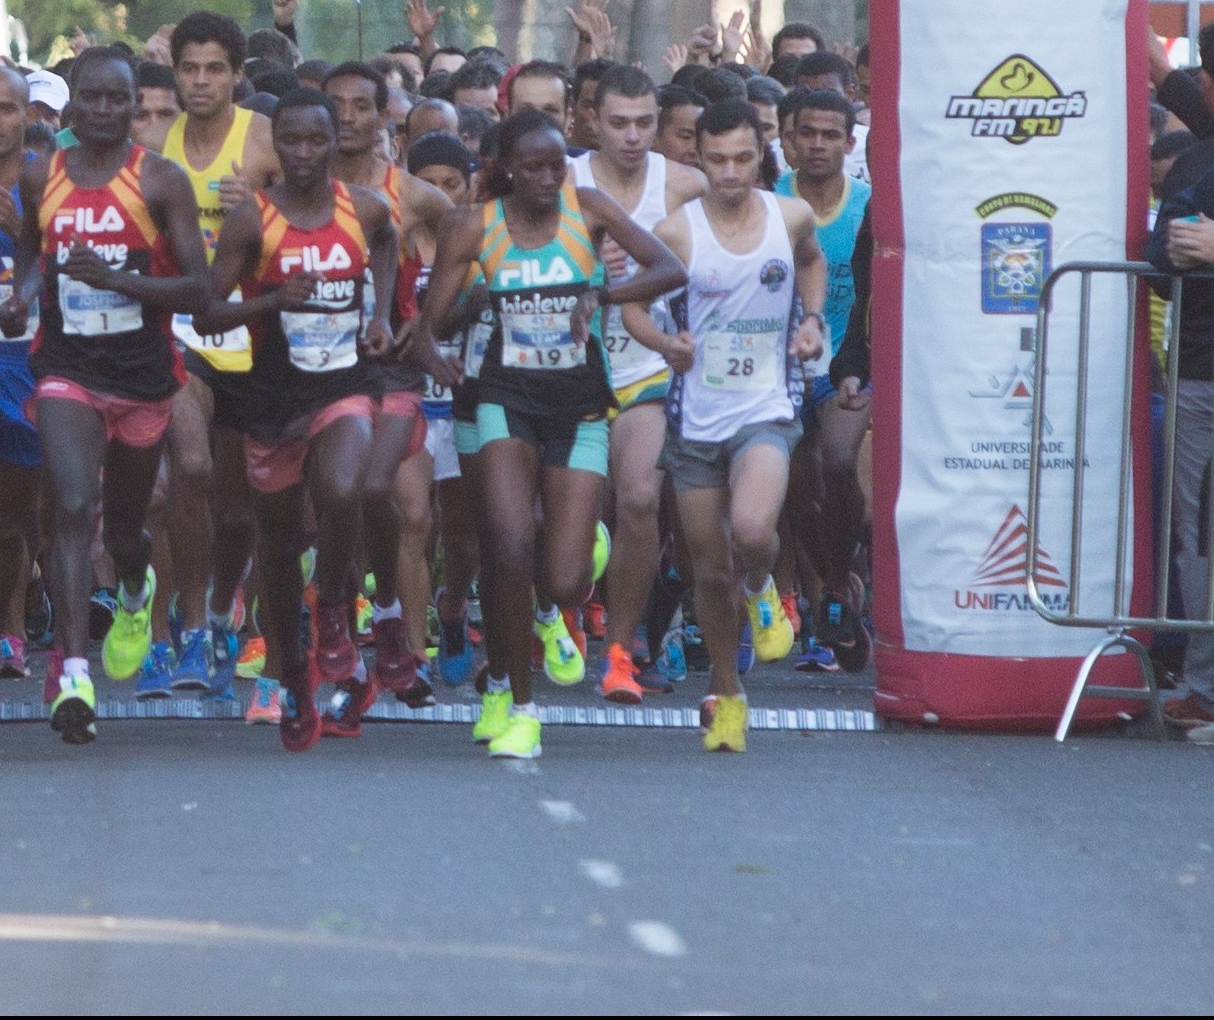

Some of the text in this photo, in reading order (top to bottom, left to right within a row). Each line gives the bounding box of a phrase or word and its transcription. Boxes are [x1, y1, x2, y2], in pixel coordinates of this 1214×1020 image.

[947, 91, 1087, 117] MARINGÁ
[972, 118, 1062, 136] FM 97.1
[55, 205, 125, 233] FILA
[280, 243, 352, 273] FILA
[500, 256, 574, 287] FILA
[99, 312, 109, 330] 1
[606, 336, 630, 354] 27
[537, 349, 561, 366] 19
[727, 357, 755, 376] 28
[971, 441, 1065, 453] UNIVERSIADE
[944, 458, 1008, 470] ESTADUAL
[1012, 458, 1030, 470] DE
